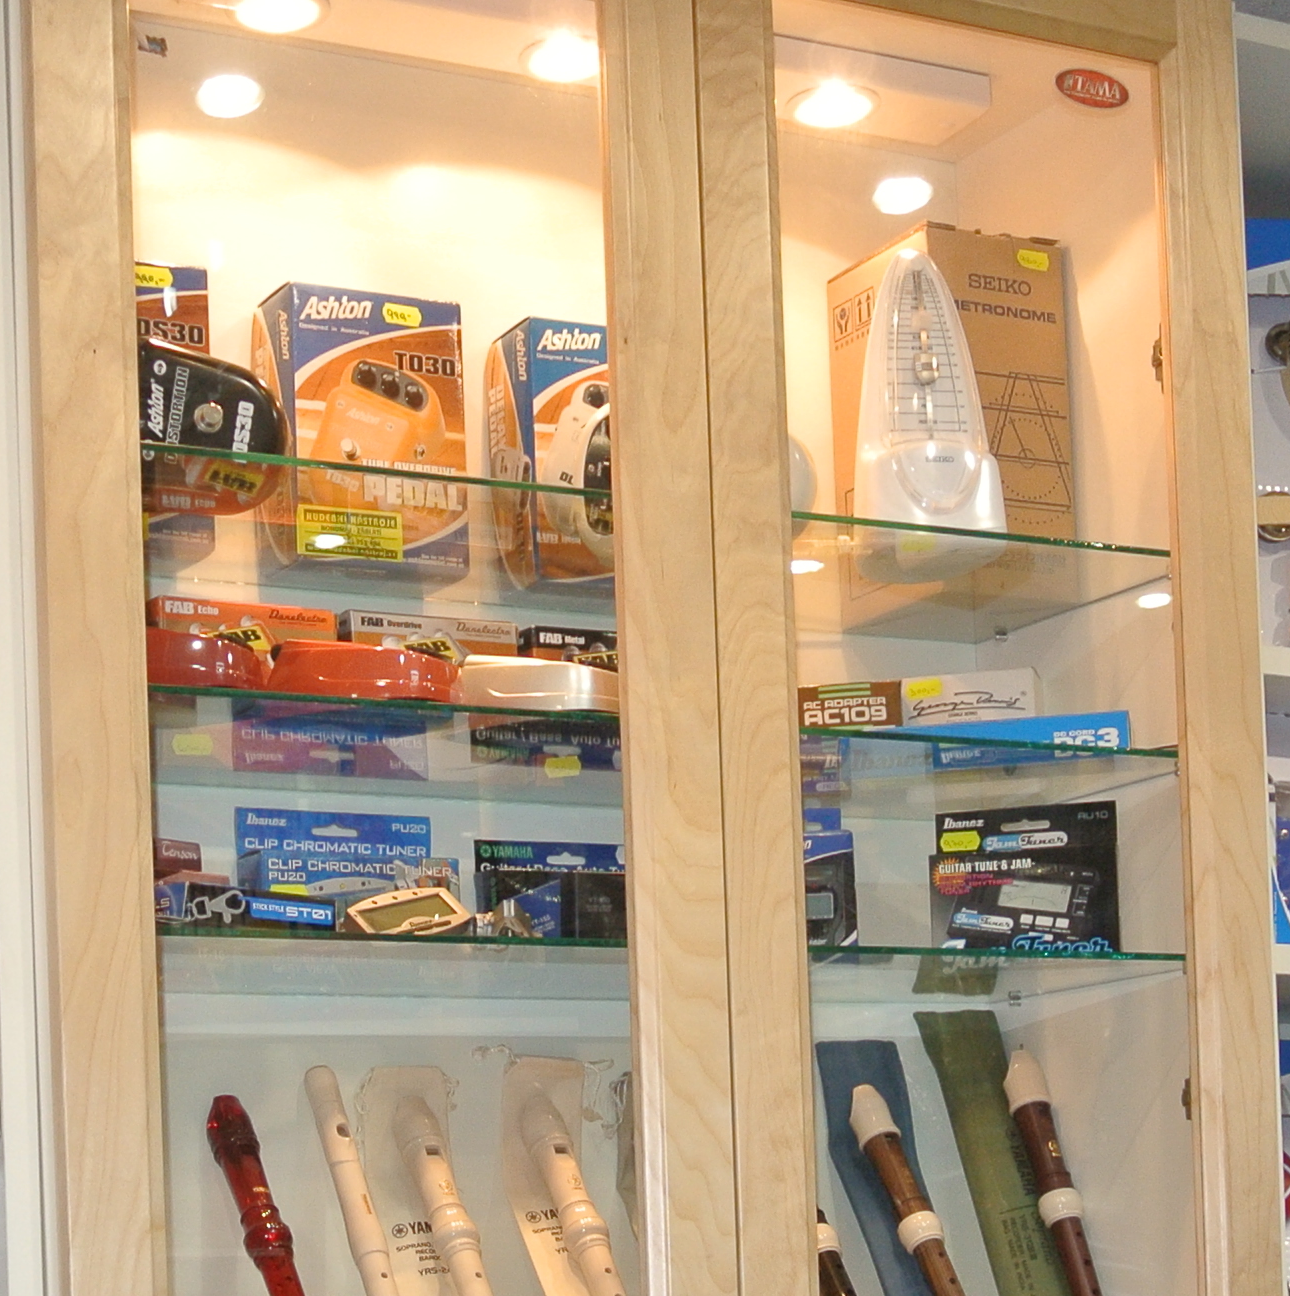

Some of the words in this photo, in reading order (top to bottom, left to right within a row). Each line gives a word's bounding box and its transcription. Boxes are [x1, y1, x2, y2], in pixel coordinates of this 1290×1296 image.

[1075, 76, 1121, 100] TAMA
[967, 272, 1032, 297] SEIKO
[300, 295, 373, 323] Ashton
[137, 316, 206, 346] DS30
[277, 308, 292, 361] Ashton
[536, 327, 603, 352] Ashton
[393, 350, 458, 378] TO30
[516, 329, 529, 382] Ashton
[148, 379, 166, 438] Ashton
[363, 474, 463, 511] PEDAL
[164, 599, 195, 615] FAB
[197, 604, 220, 616] Echo
[360, 615, 385, 627] FAB
[387, 619, 423, 631] Overdrive
[538, 631, 563, 645] FAB
[564, 634, 586, 645] Metal
[803, 700, 822, 711] AC
[824, 697, 886, 708] ADAPTER
[804, 705, 887, 727] AC109
[246, 813, 288, 826] Ibanez
[943, 817, 985, 830] Ibanez
[1077, 810, 1109, 820] AU10
[392, 823, 427, 834] PU20
[244, 837, 279, 850] CLIP
[283, 839, 372, 856] CHROMATIC
[376, 843, 427, 857] TUNER
[1020, 833, 1067, 847] Tuner
[491, 845, 534, 860] YAMAHA
[268, 858, 303, 870] CLIP
[307, 859, 397, 876] CHROMATIC
[938, 862, 972, 875] GUITAR
[974, 860, 1000, 873] TUNE
[268, 871, 307, 883] PU20
[285, 906, 333, 922] ST01
